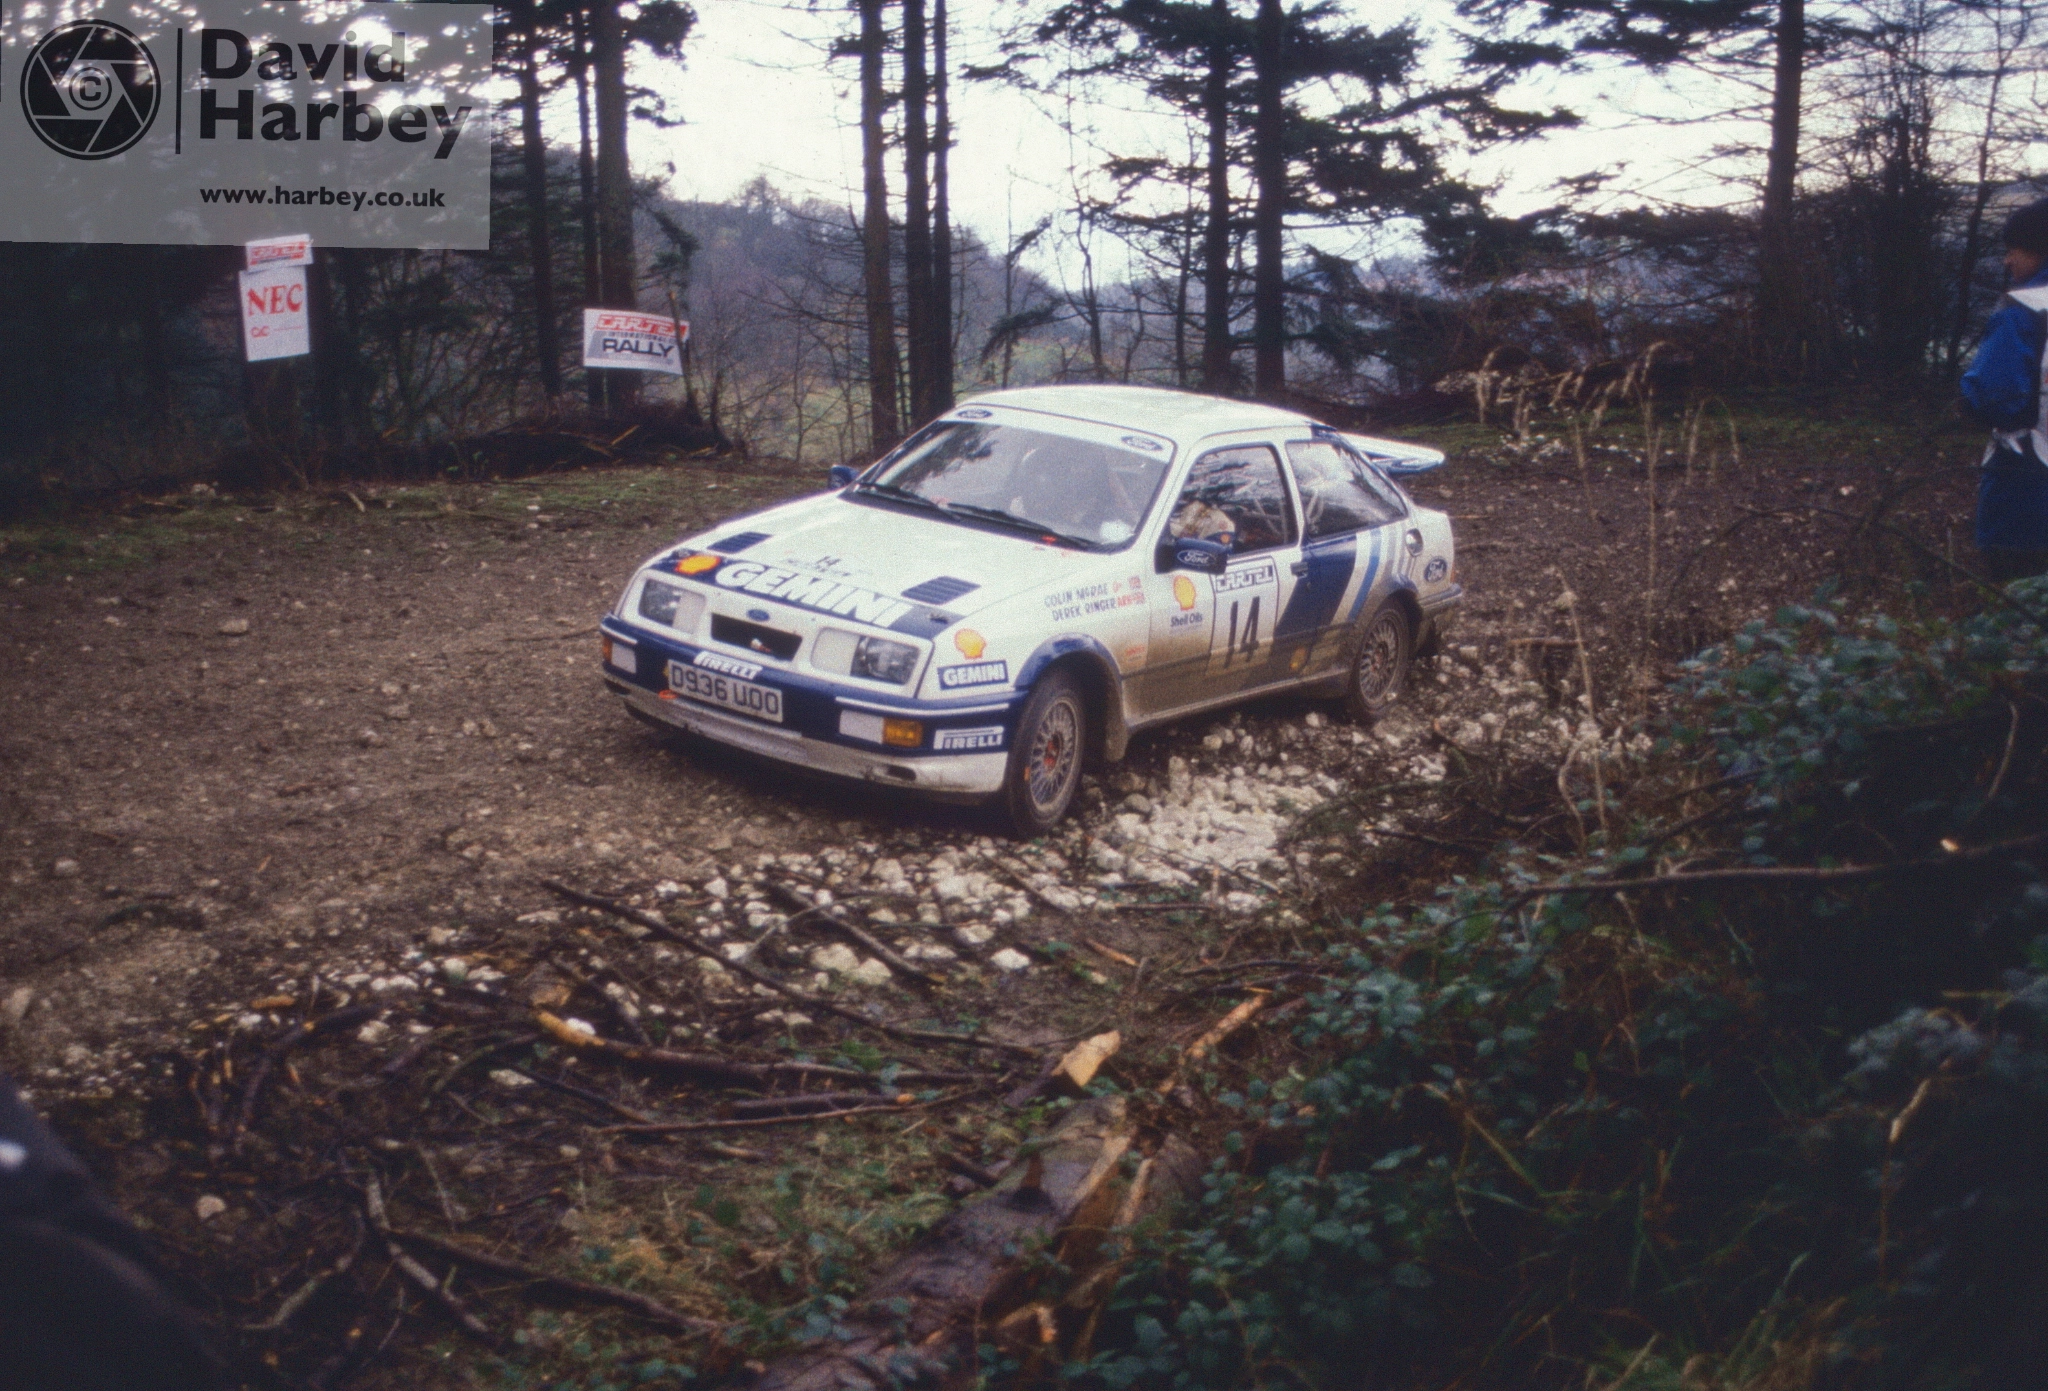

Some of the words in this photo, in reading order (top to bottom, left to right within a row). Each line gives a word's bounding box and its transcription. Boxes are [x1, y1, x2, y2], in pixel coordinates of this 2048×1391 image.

[247, 283, 304, 317] NEC
[602, 338, 674, 357] RALLY
[1184, 550, 1209, 564] Ford
[1215, 565, 1274, 593] CARTEL
[715, 562, 914, 629] GEMINI
[1045, 591, 1073, 608] COLIN
[1052, 605, 1082, 621] DEREK
[1084, 598, 1116, 614] RINGER
[1170, 613, 1189, 627] Shell
[1223, 595, 1260, 669] 14
[693, 650, 763, 680] PIRELLI
[943, 663, 1006, 687] GEMINI
[672, 663, 728, 701] D936
[933, 726, 1004, 749] PIRELLI
